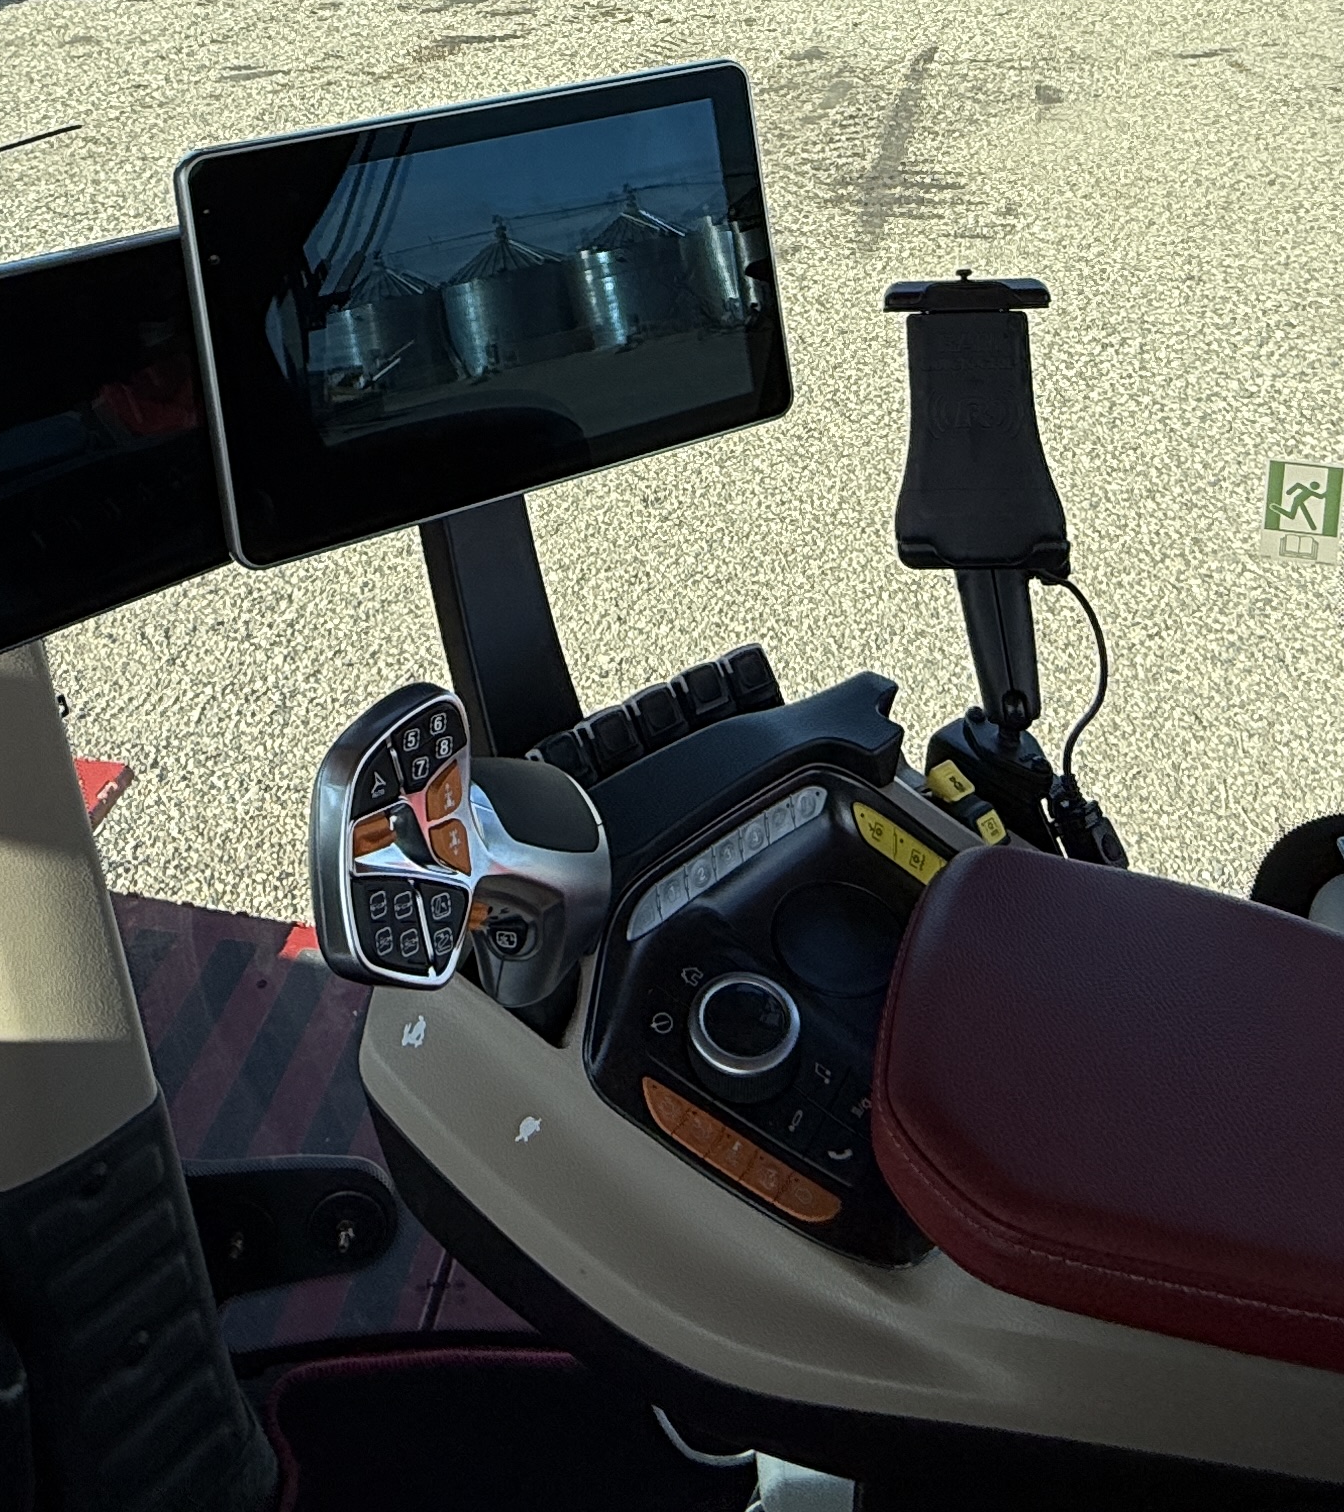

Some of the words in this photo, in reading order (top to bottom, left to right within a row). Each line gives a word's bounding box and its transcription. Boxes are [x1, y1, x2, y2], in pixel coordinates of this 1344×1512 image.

[433, 716, 443, 731] 6
[407, 732, 416, 748] 5
[439, 739, 449, 755] 8
[416, 760, 426, 776] 7
